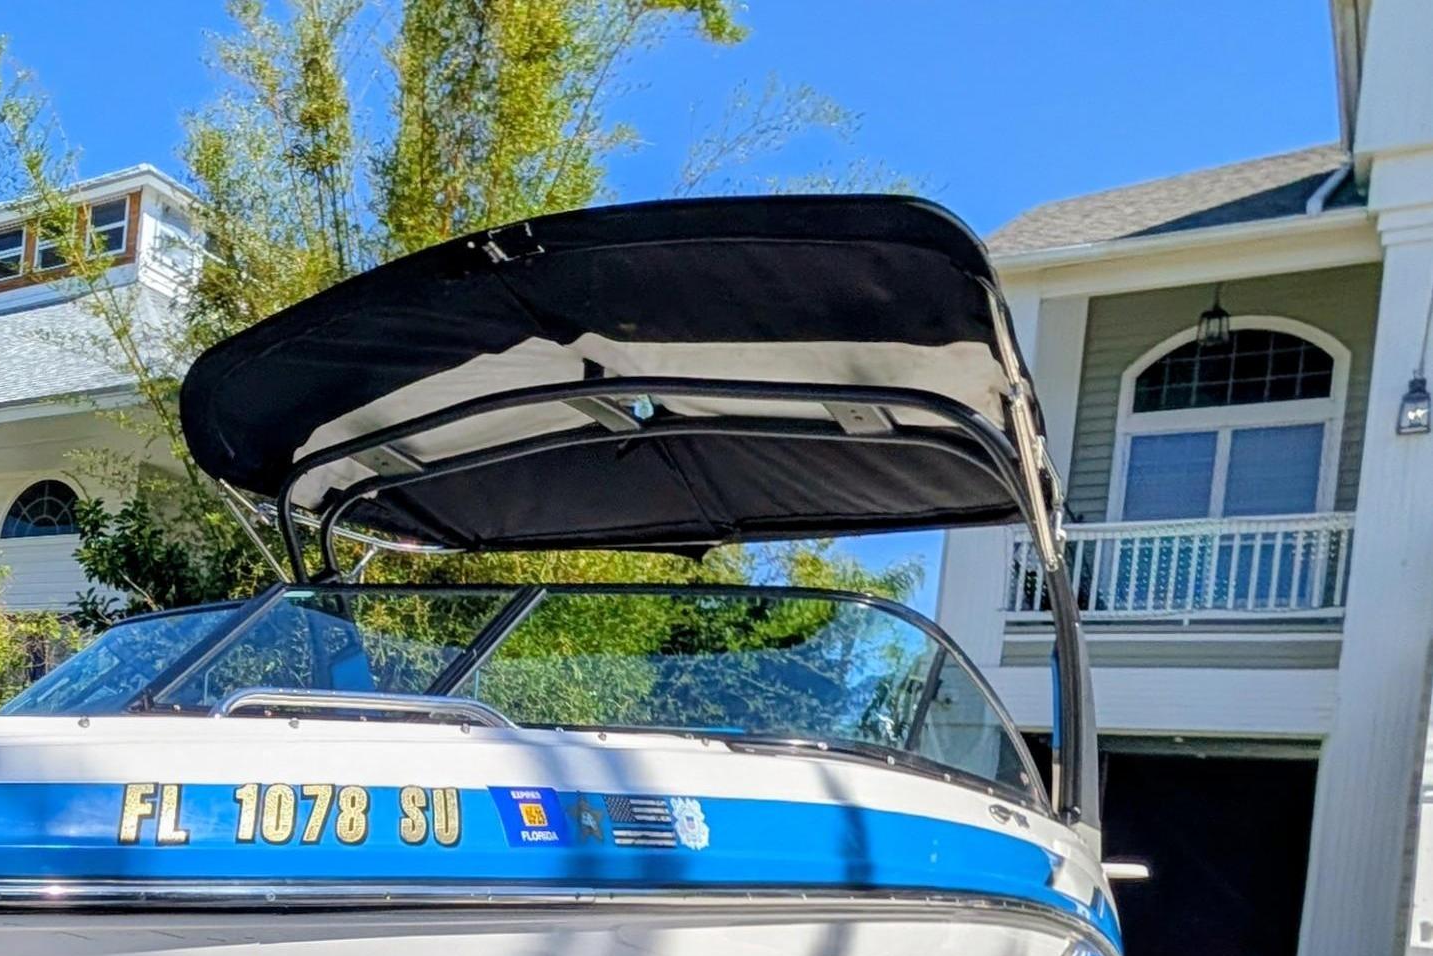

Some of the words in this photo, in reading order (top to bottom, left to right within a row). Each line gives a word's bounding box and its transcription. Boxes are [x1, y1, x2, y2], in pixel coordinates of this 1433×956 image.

[119, 781, 190, 846] FL
[233, 782, 370, 847] 1078
[399, 784, 462, 848] SU
[520, 829, 560, 842] FLORIDA
